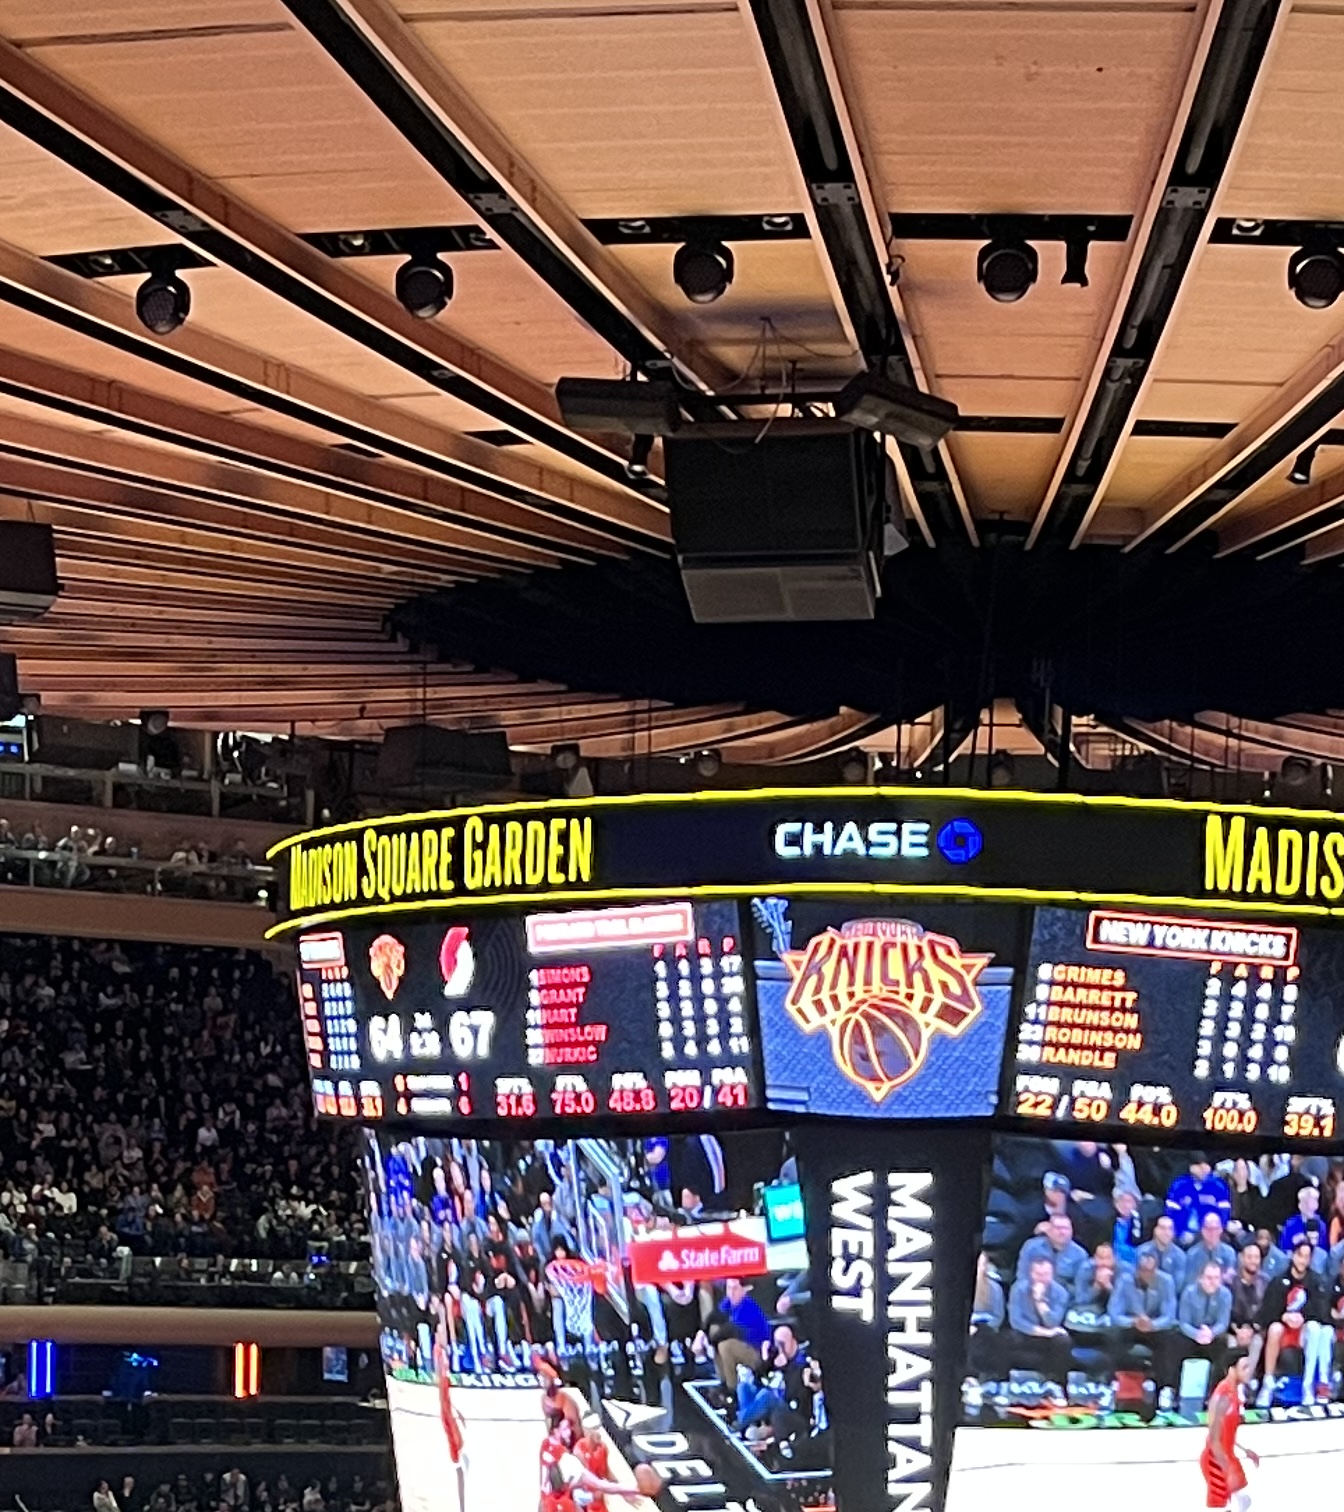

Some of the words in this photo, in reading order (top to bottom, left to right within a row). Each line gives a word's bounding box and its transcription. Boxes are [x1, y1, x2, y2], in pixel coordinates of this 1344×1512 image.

[773, 820, 931, 860] CHASE
[289, 840, 358, 911] MADISON
[361, 826, 455, 902] SQUARE
[464, 815, 593, 890] GARDEN
[1098, 918, 1152, 946] NEW
[1153, 924, 1210, 950] YORK
[1210, 929, 1288, 958] KNICKS
[786, 935, 981, 1014] KNICKS
[1053, 964, 1127, 988] GRIMES
[1047, 1004, 1140, 1030] BRUNSON
[1049, 985, 1139, 1009] BARRETT
[368, 1013, 404, 1062] 64
[449, 1009, 496, 1061] 67
[1043, 1023, 1143, 1050] ROBINSON
[1041, 1045, 1118, 1069] RANDLE
[551, 1090, 596, 1114] 75.0
[608, 1088, 657, 1113] 48.8
[669, 1086, 702, 1111] 20
[717, 1084, 748, 1107] 41
[1016, 1092, 1054, 1117] 22
[1072, 1097, 1108, 1121] 50
[1119, 1102, 1178, 1128] 44.0
[1202, 1107, 1258, 1133] 100.0
[1283, 1112, 1334, 1138] 39.1
[830, 1169, 875, 1323] WEST
